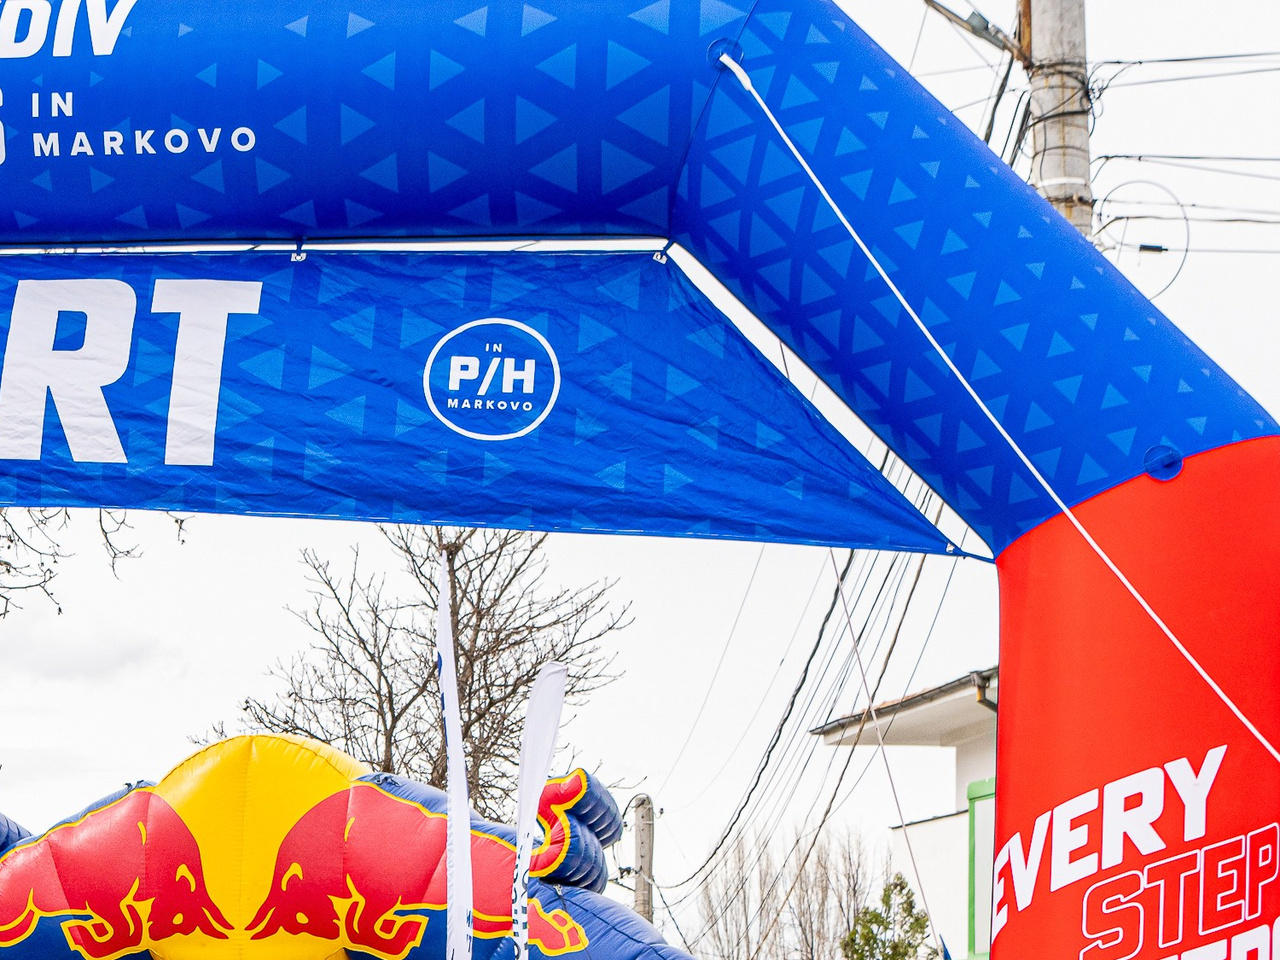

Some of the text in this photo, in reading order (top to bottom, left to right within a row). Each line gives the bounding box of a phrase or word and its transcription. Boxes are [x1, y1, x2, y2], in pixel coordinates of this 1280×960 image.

[31, 92, 74, 118] IN
[32, 127, 257, 157] MARKOVO
[485, 343, 502, 353] IN
[448, 356, 536, 396] P/H
[447, 398, 533, 412] MARKOVO
[991, 744, 1228, 945] EVERY
